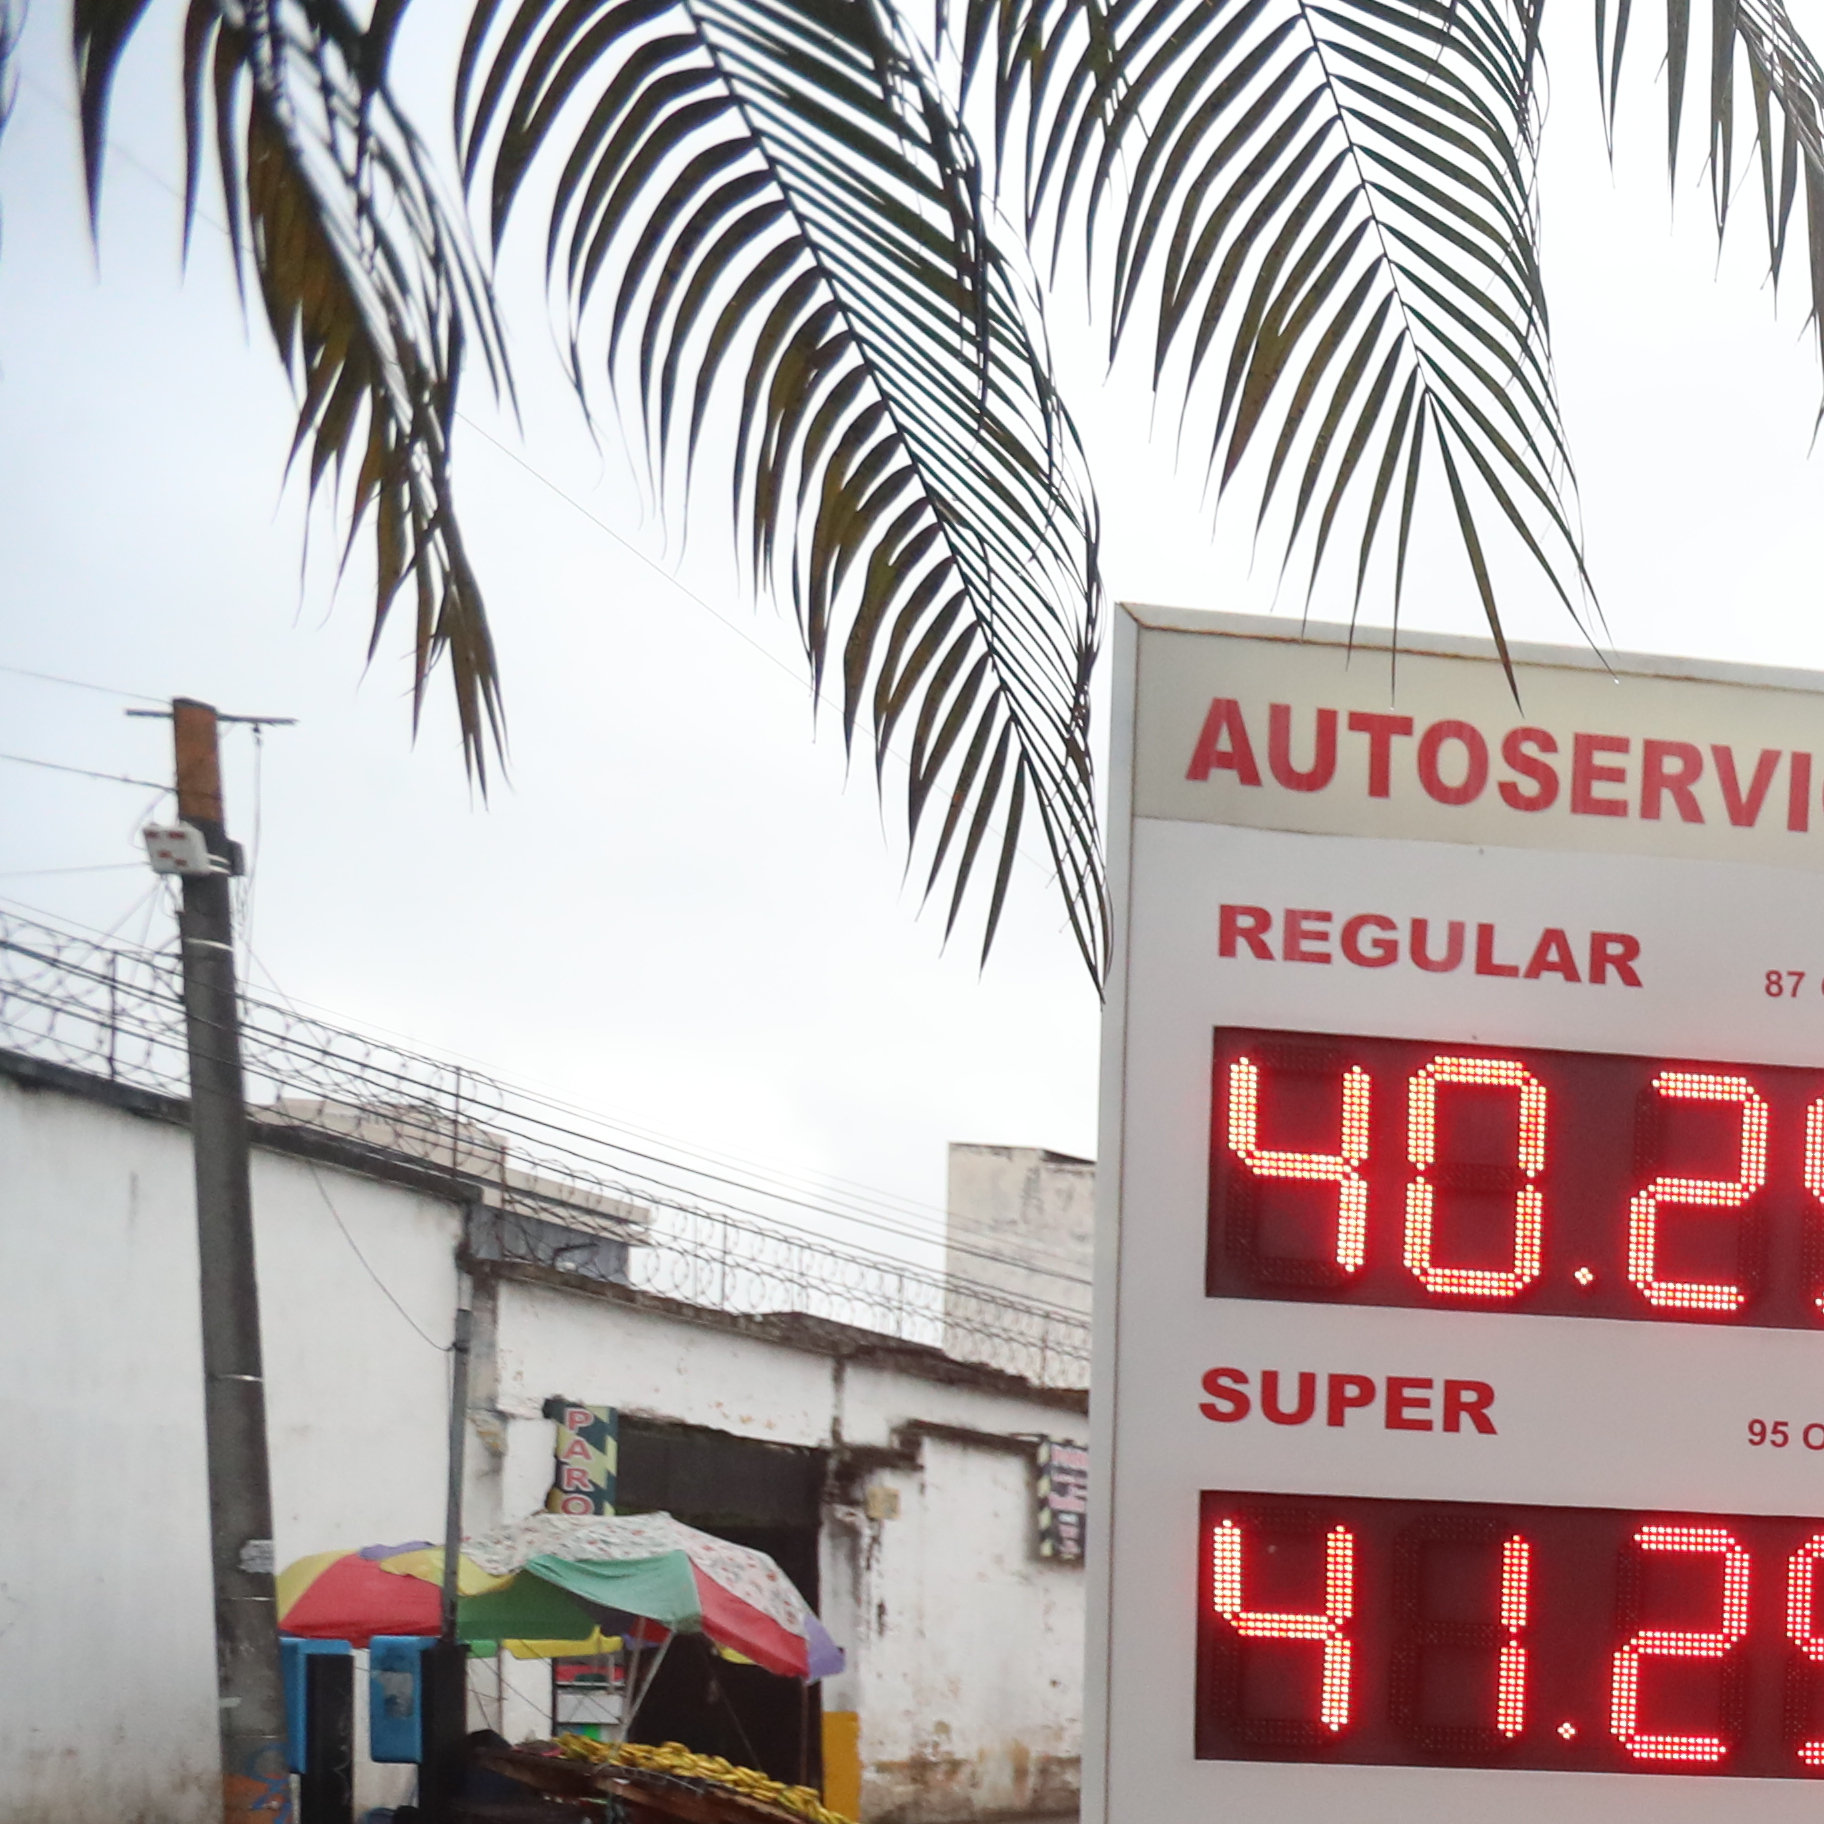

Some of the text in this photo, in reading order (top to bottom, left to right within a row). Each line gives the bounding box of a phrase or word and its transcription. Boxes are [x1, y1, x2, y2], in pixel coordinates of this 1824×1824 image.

[1218, 903, 1644, 988] REGULAR
[1764, 969, 1806, 998] 87
[1198, 1366, 1498, 1436] SUPER
[1747, 1418, 1791, 1449] 95
